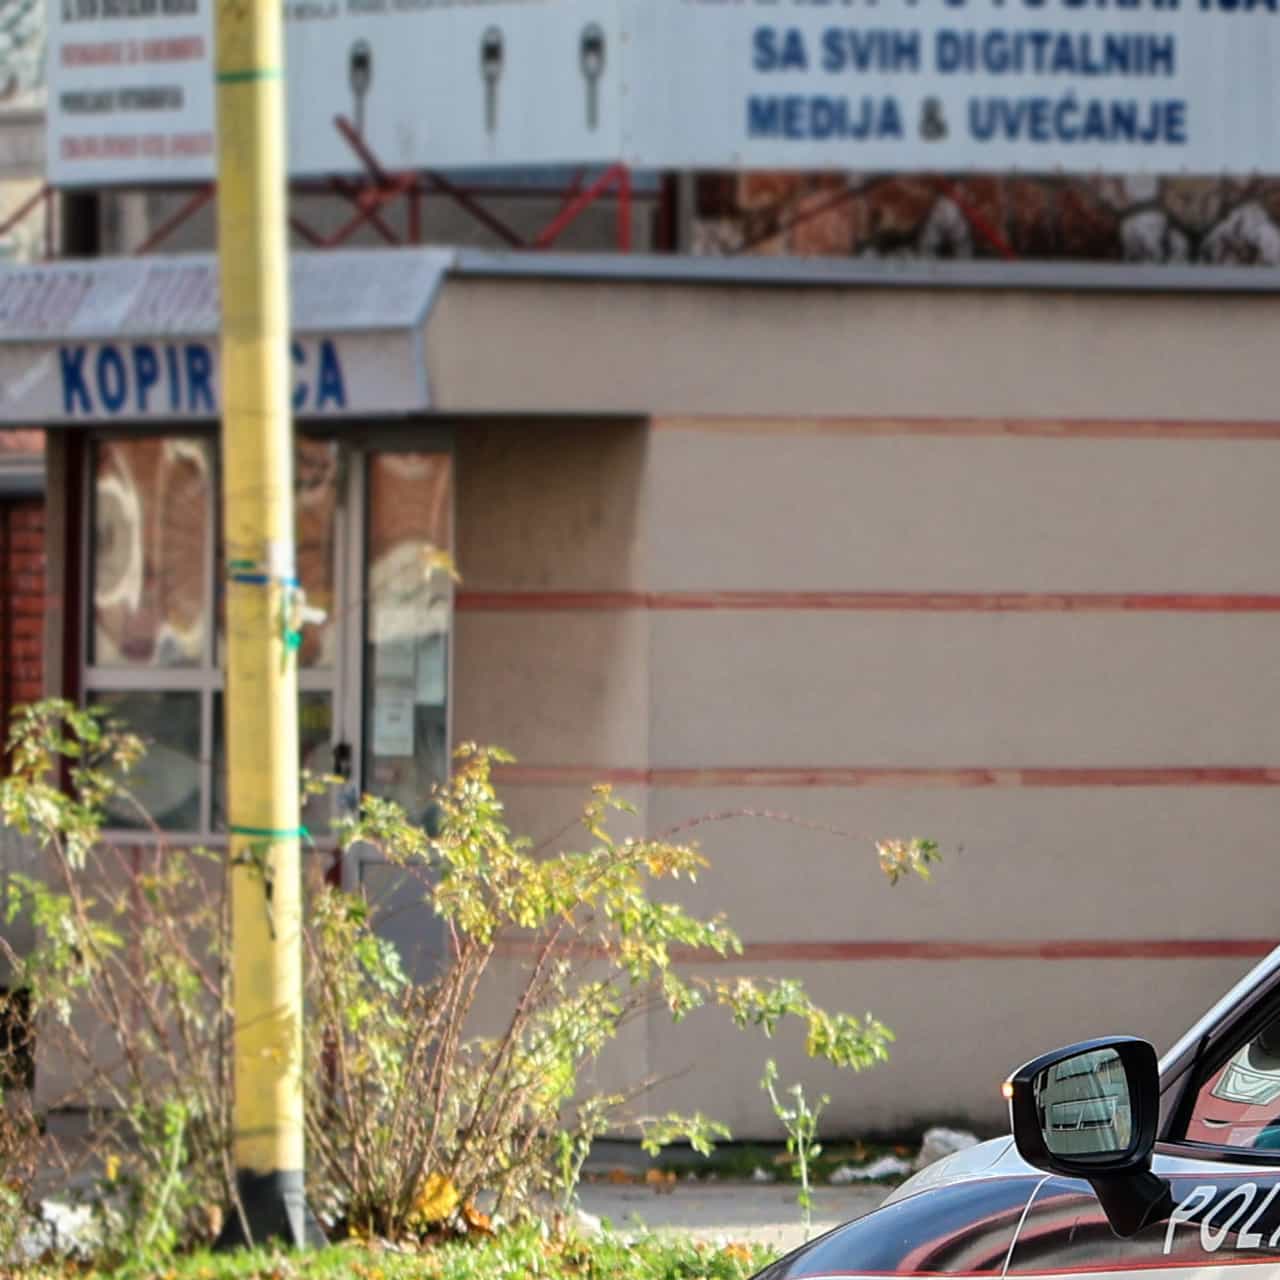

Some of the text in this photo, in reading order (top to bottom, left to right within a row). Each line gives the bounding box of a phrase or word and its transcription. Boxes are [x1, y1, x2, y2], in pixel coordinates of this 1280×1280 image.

[753, 27, 1176, 77] SA SVIH DIGITALNIH
[746, 92, 1188, 145] MEDIJA & UVEĆANJE
[58, 336, 347, 414] KOPIRCA
